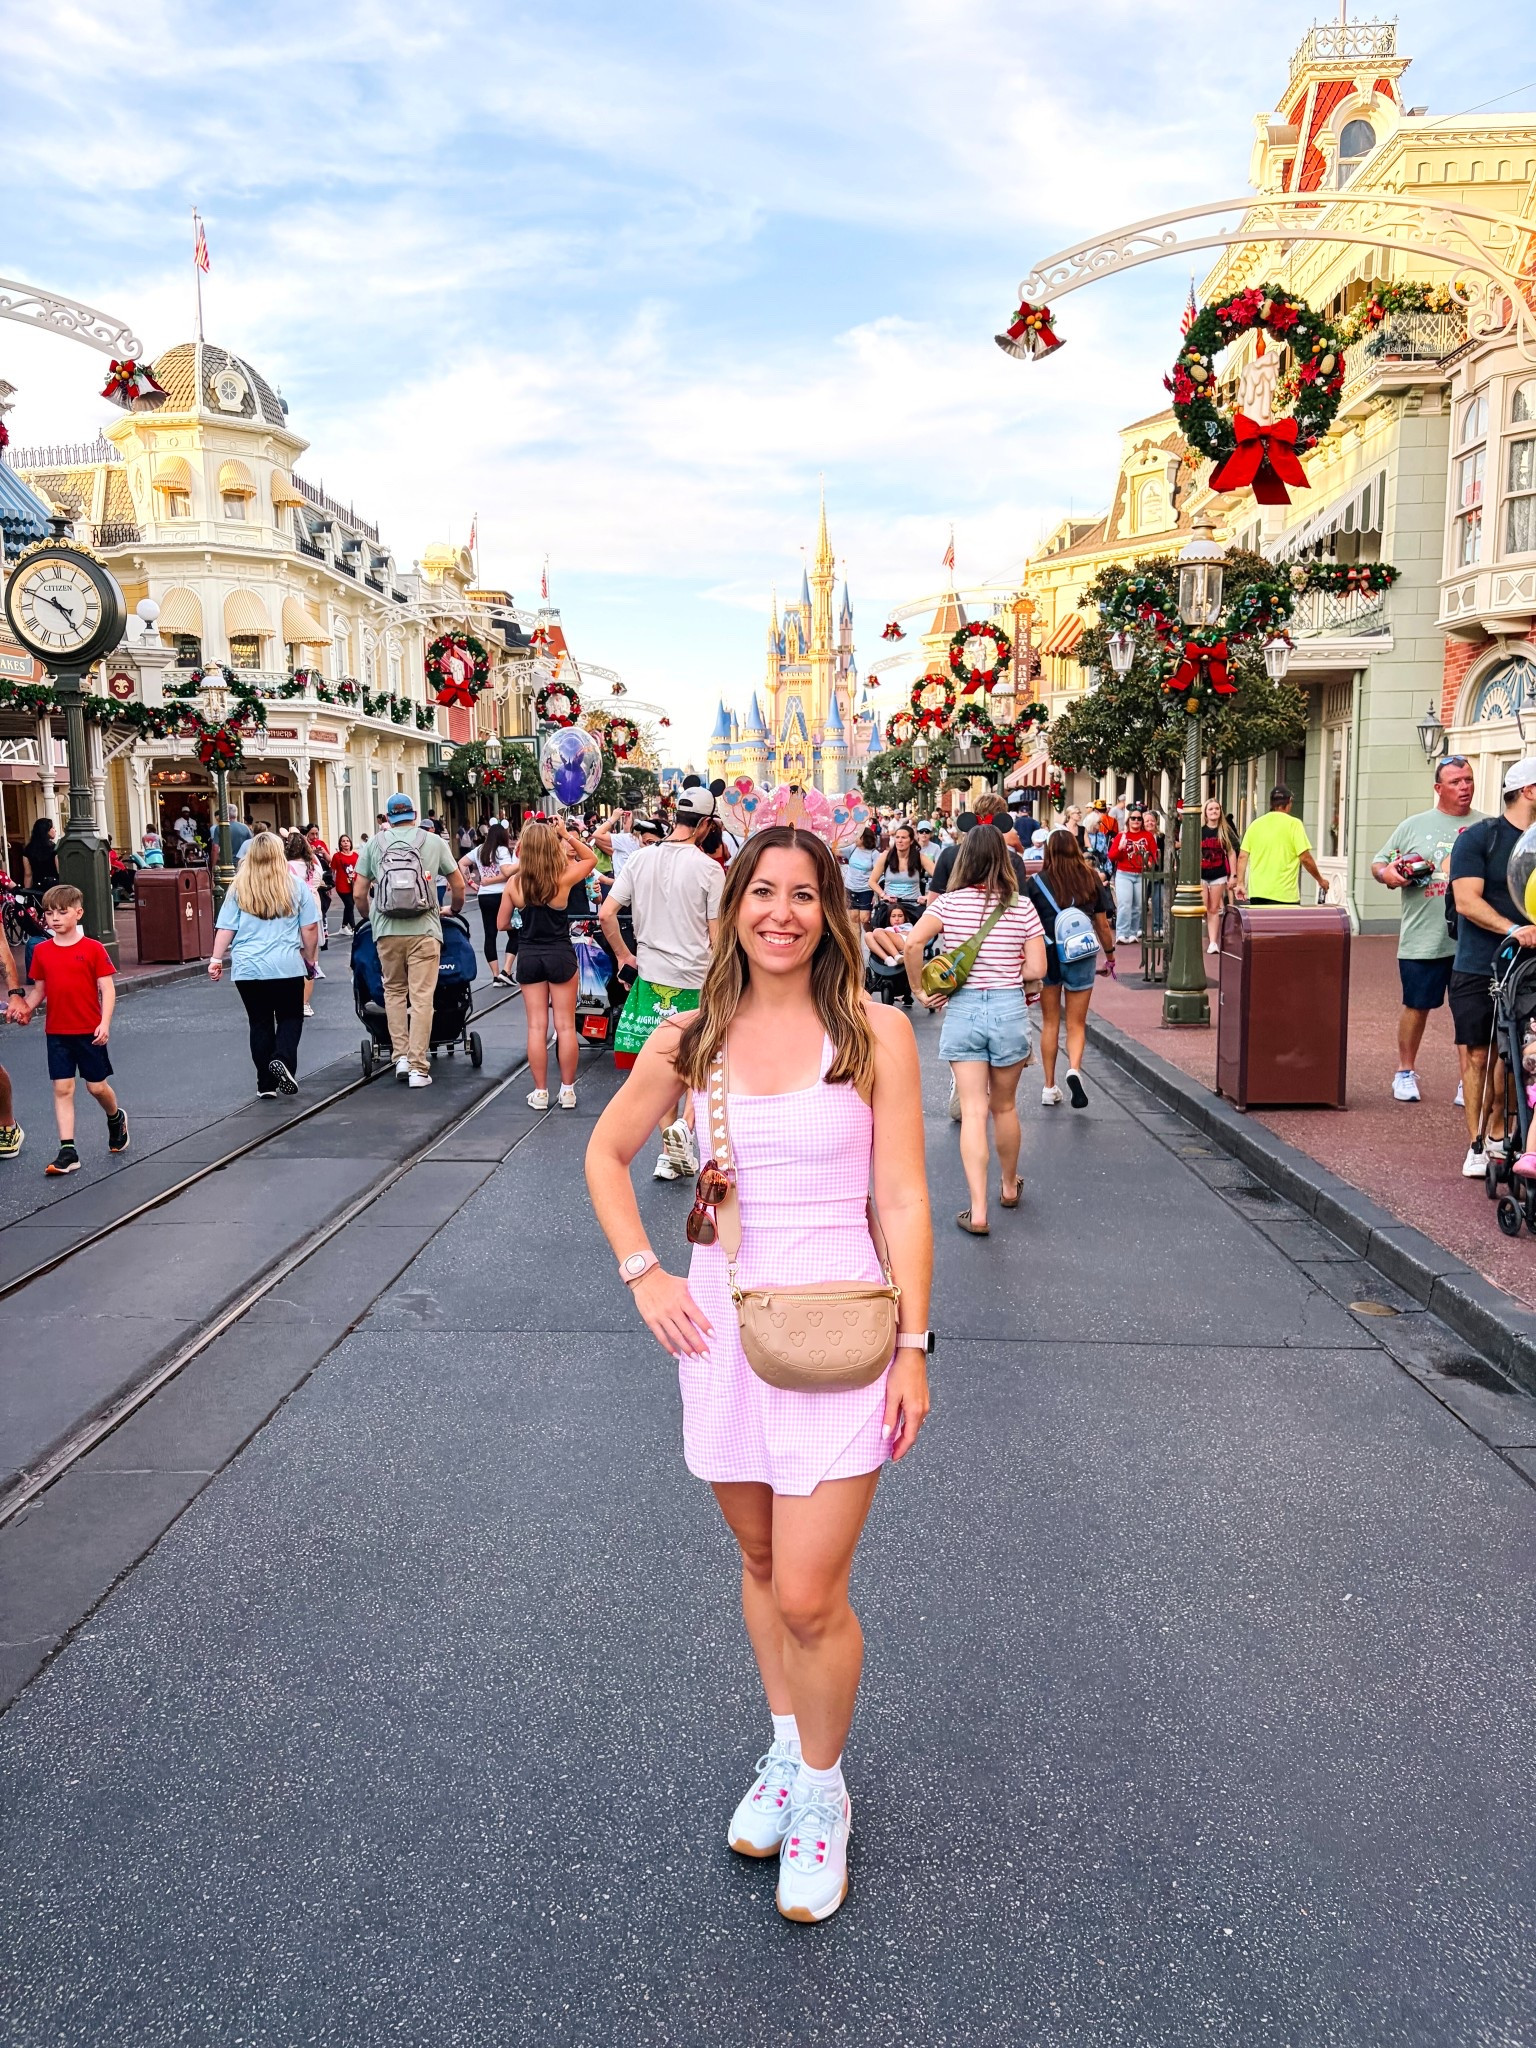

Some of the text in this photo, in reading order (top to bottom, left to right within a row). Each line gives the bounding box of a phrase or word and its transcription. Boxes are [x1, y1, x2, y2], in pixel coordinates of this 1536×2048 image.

[1018, 613, 1028, 659] CRYSTAL
[0, 659, 26, 671] AKES
[1017, 664, 1027, 690] ARTS
